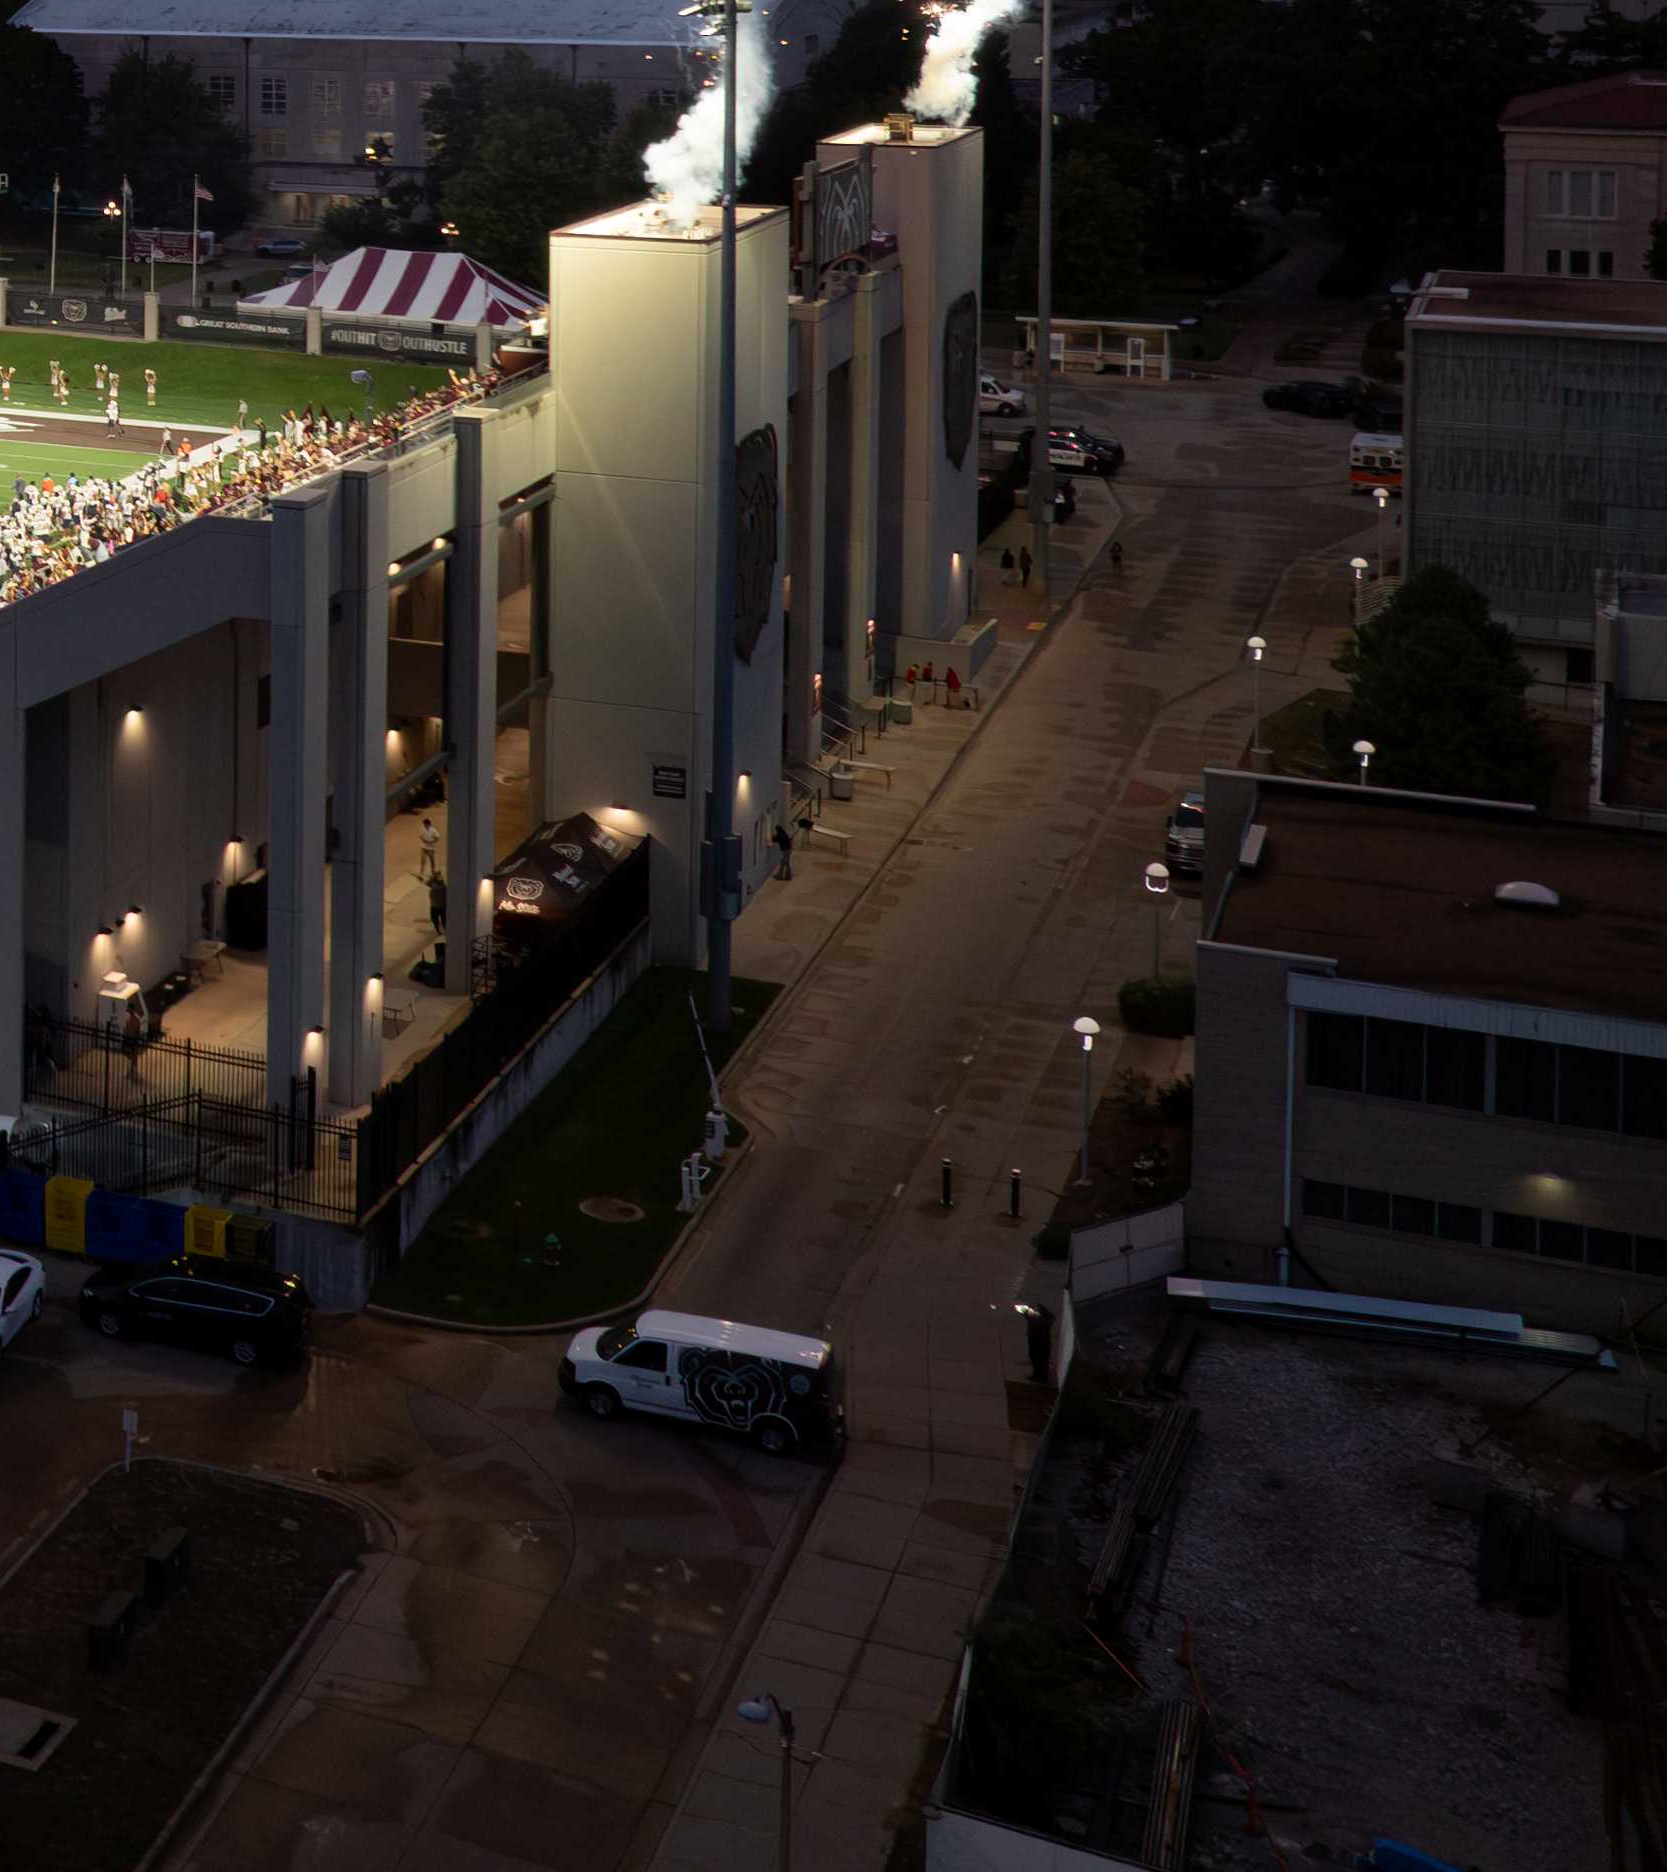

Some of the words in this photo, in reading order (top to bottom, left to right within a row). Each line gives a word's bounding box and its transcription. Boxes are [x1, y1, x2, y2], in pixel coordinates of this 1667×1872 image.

[267, 324, 291, 335] BANK
[330, 329, 377, 345] #OUTHIT
[402, 336, 468, 355] OUTHUSTLE
